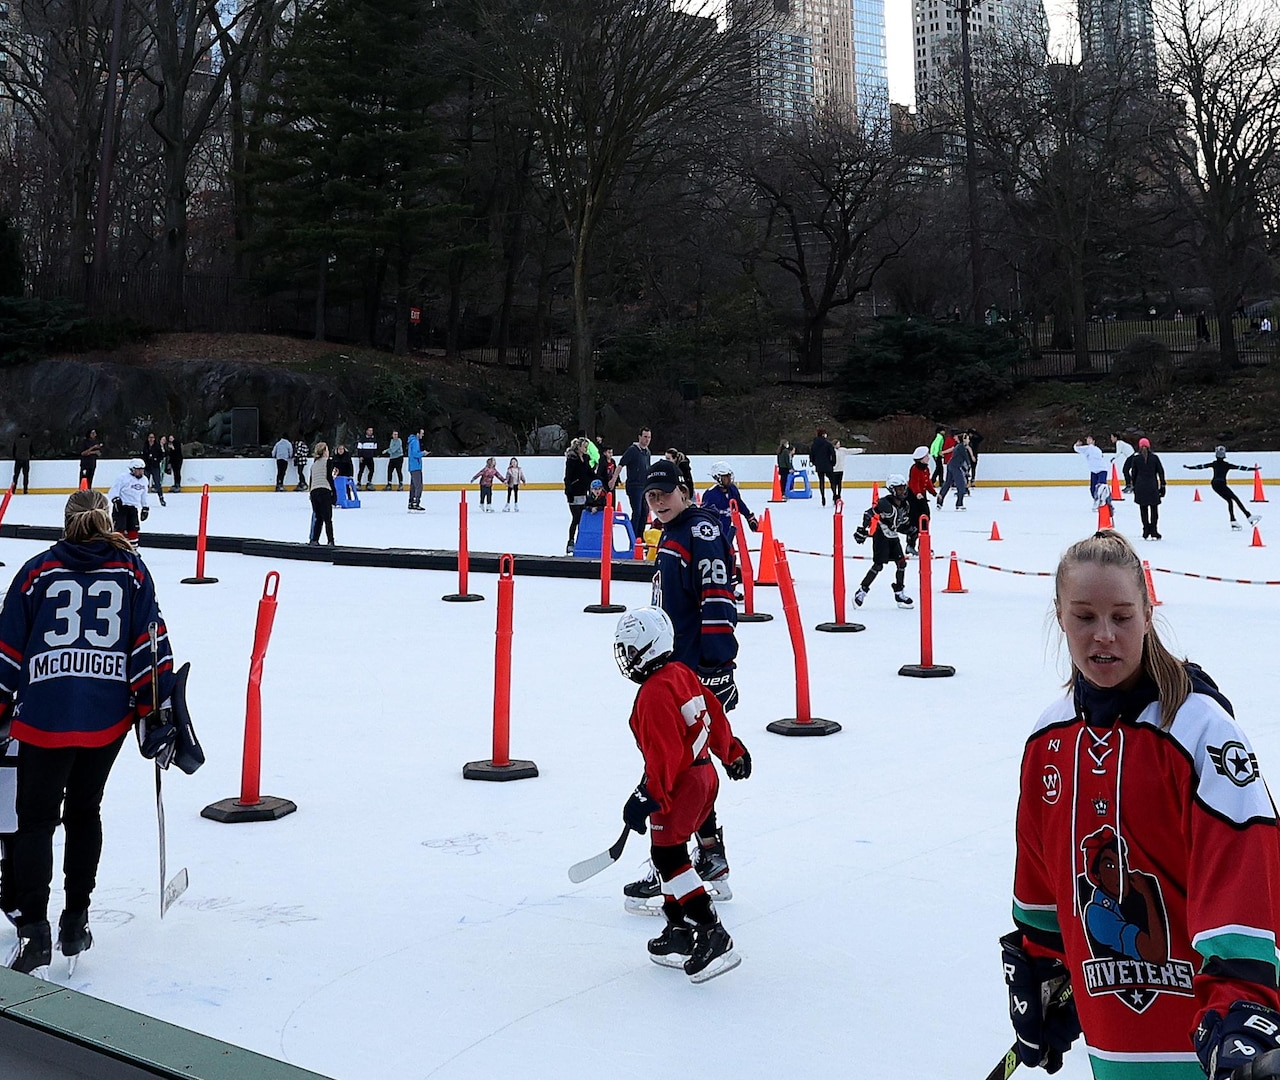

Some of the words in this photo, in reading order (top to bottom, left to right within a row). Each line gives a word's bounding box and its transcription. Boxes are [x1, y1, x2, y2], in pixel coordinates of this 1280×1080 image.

[697, 558, 728, 585] 28
[44, 580, 123, 648] 33
[34, 651, 125, 678] McQUIGGE
[1085, 960, 1193, 990] RIVETERS
